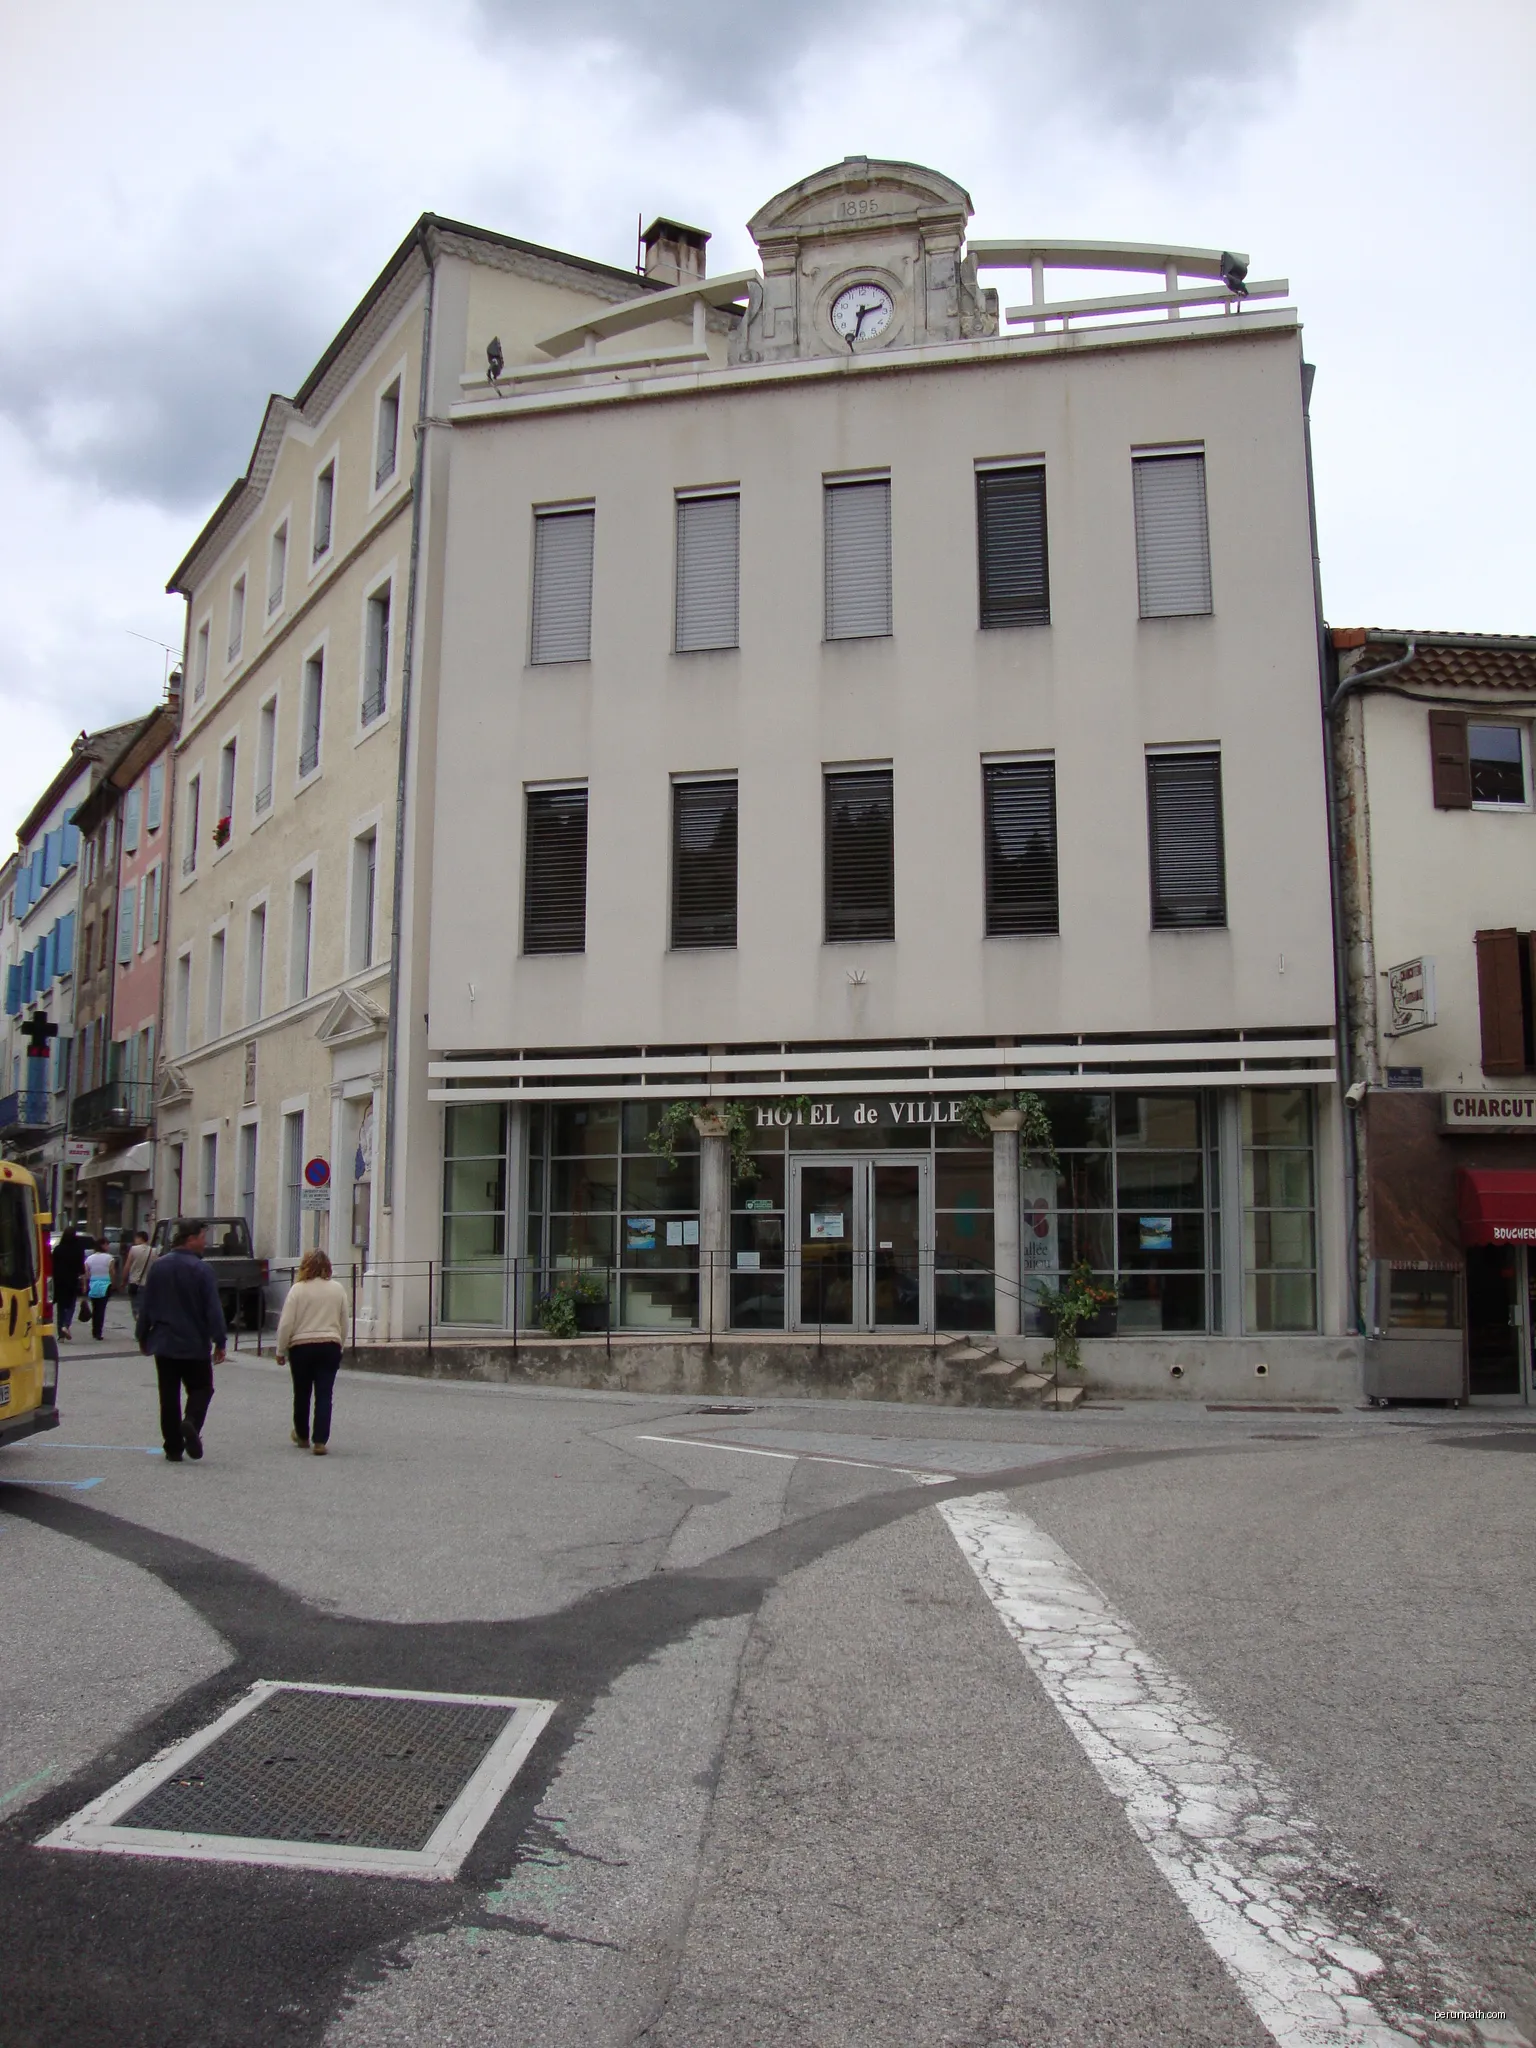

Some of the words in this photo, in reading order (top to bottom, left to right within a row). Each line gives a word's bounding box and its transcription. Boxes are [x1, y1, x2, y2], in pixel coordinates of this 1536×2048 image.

[841, 199, 879, 216] 1895
[854, 1103, 878, 1124] de
[889, 1101, 963, 1124] VILLE
[1453, 1098, 1536, 1117] CHARCUT
[1024, 1241, 1048, 1256] allée
